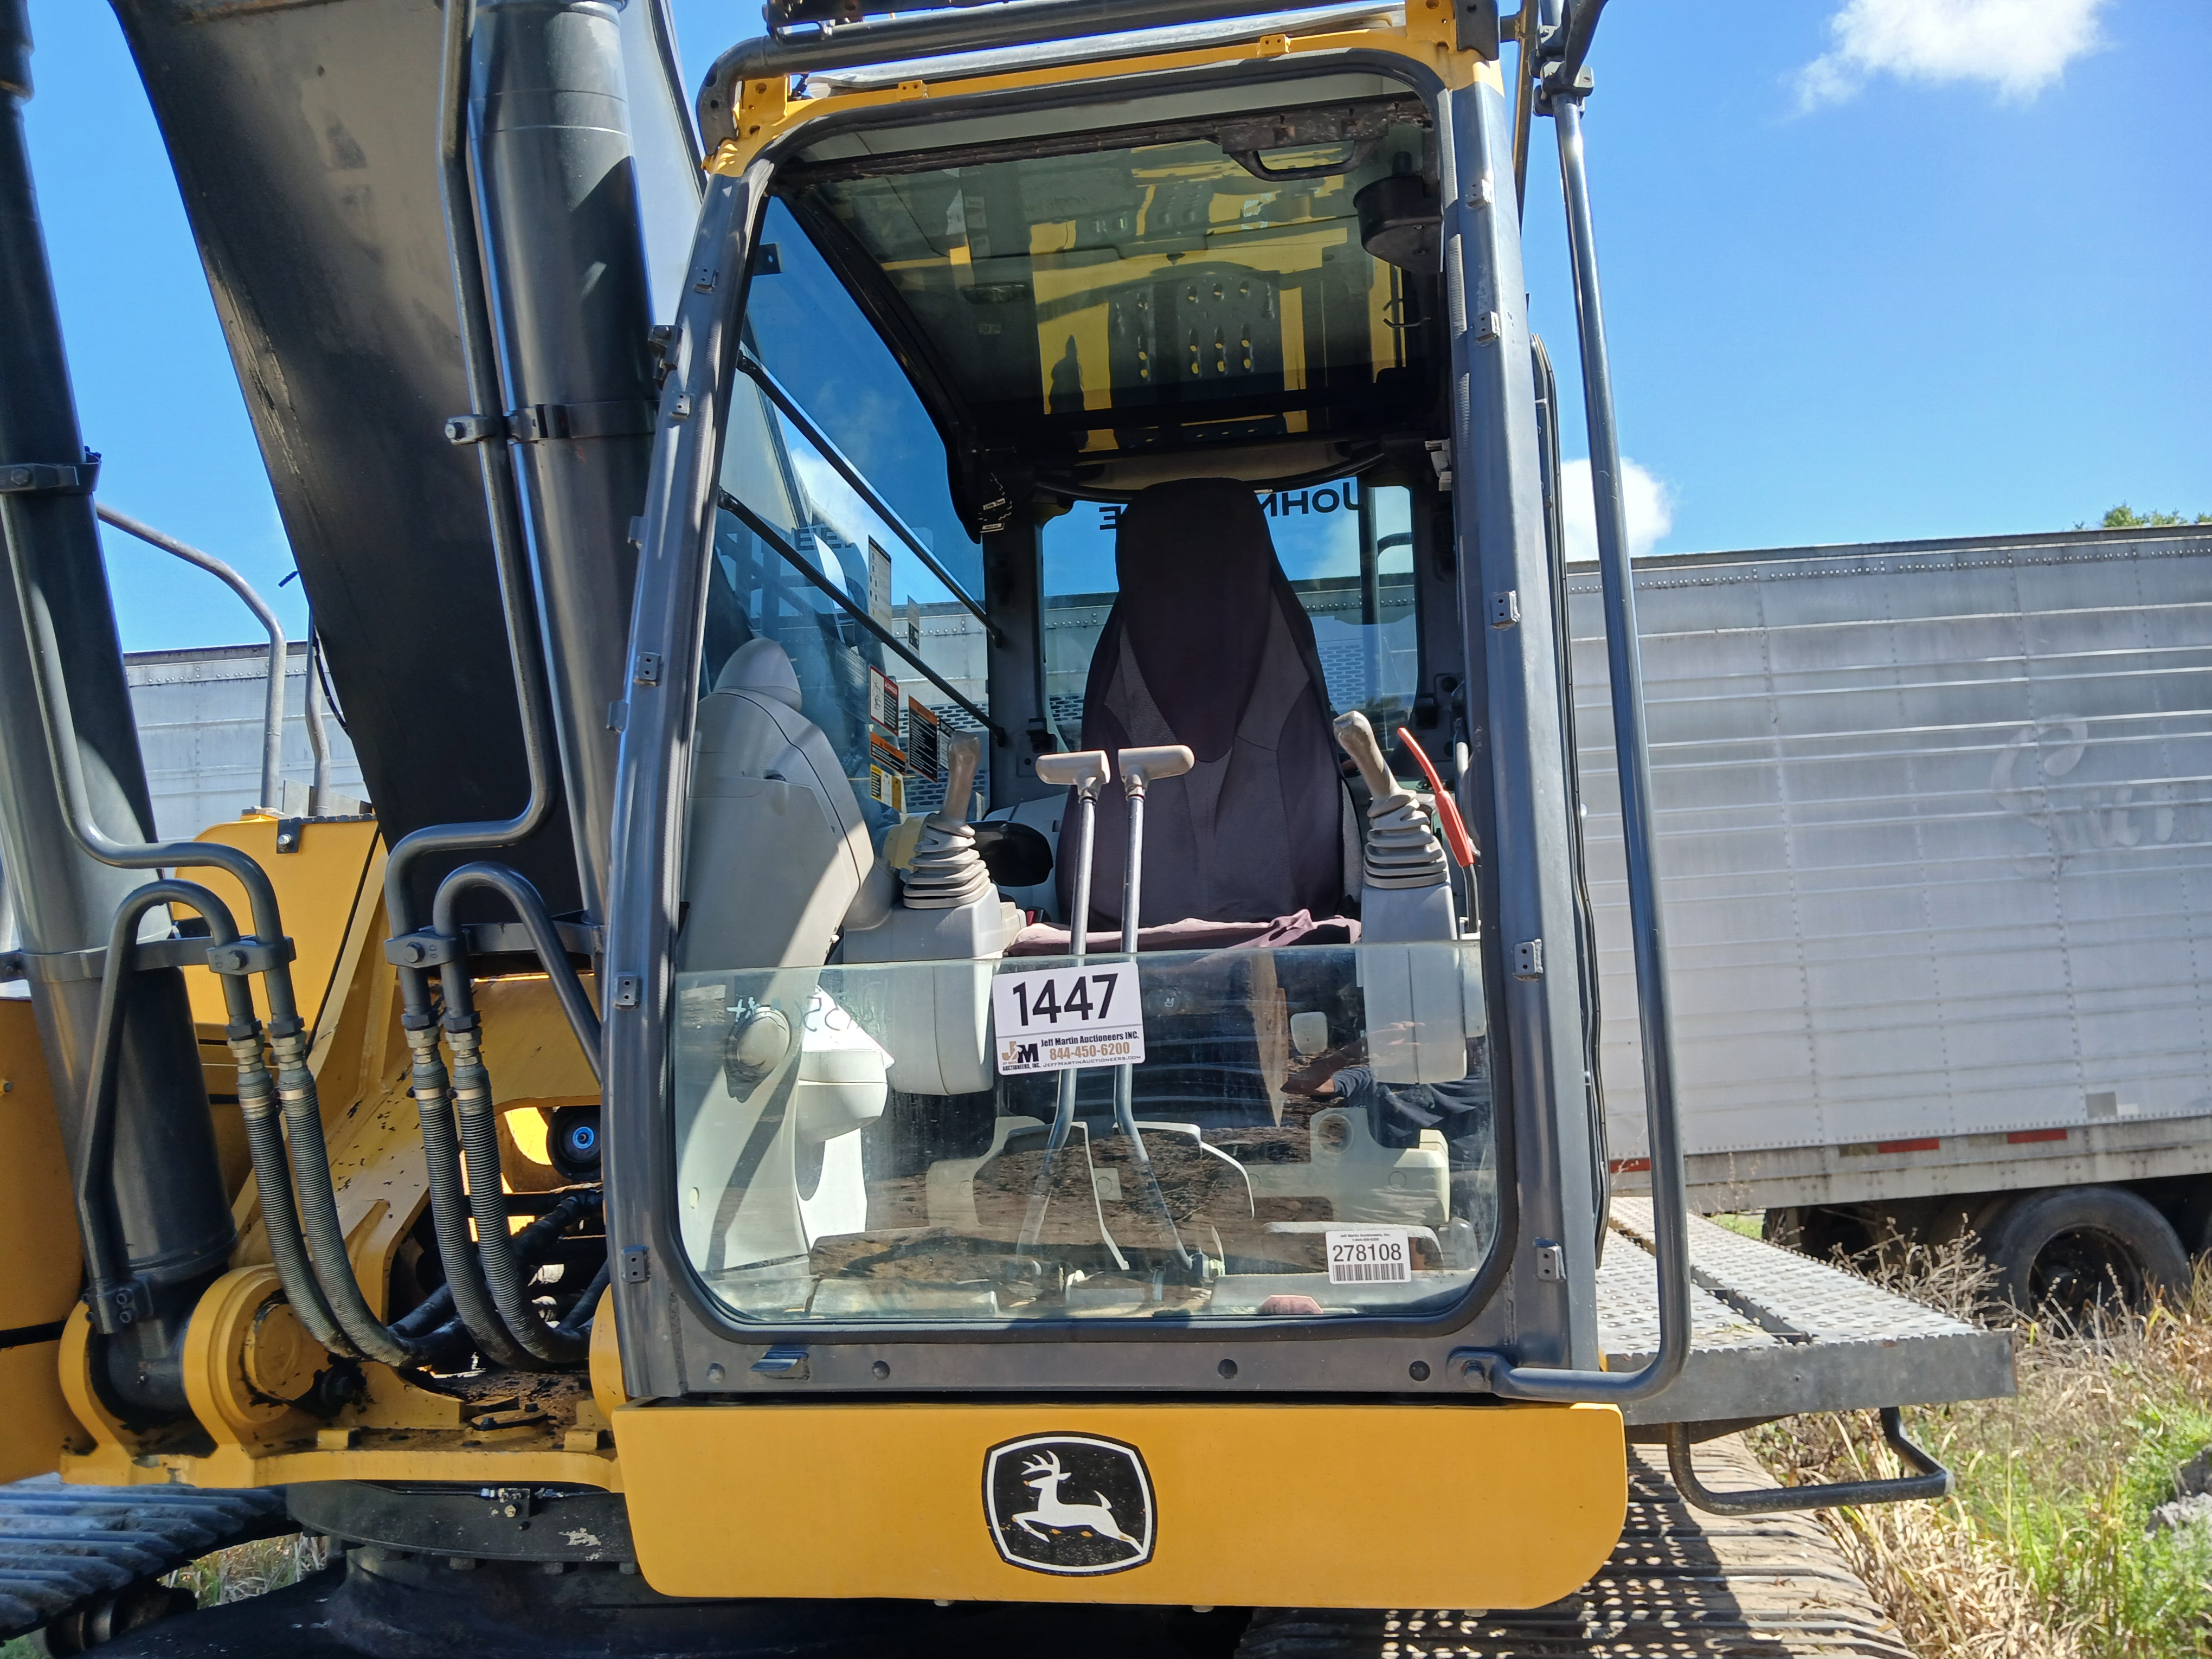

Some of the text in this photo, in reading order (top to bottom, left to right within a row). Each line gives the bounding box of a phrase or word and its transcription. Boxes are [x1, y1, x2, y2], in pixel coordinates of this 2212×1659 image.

[1013, 973, 1118, 1026] 1447
[1041, 1031, 1140, 1047] Jeff Martin Auctioneers INC.
[1049, 1041, 1130, 1060] 844-450-6200
[1333, 1243, 1401, 1262] 278108
